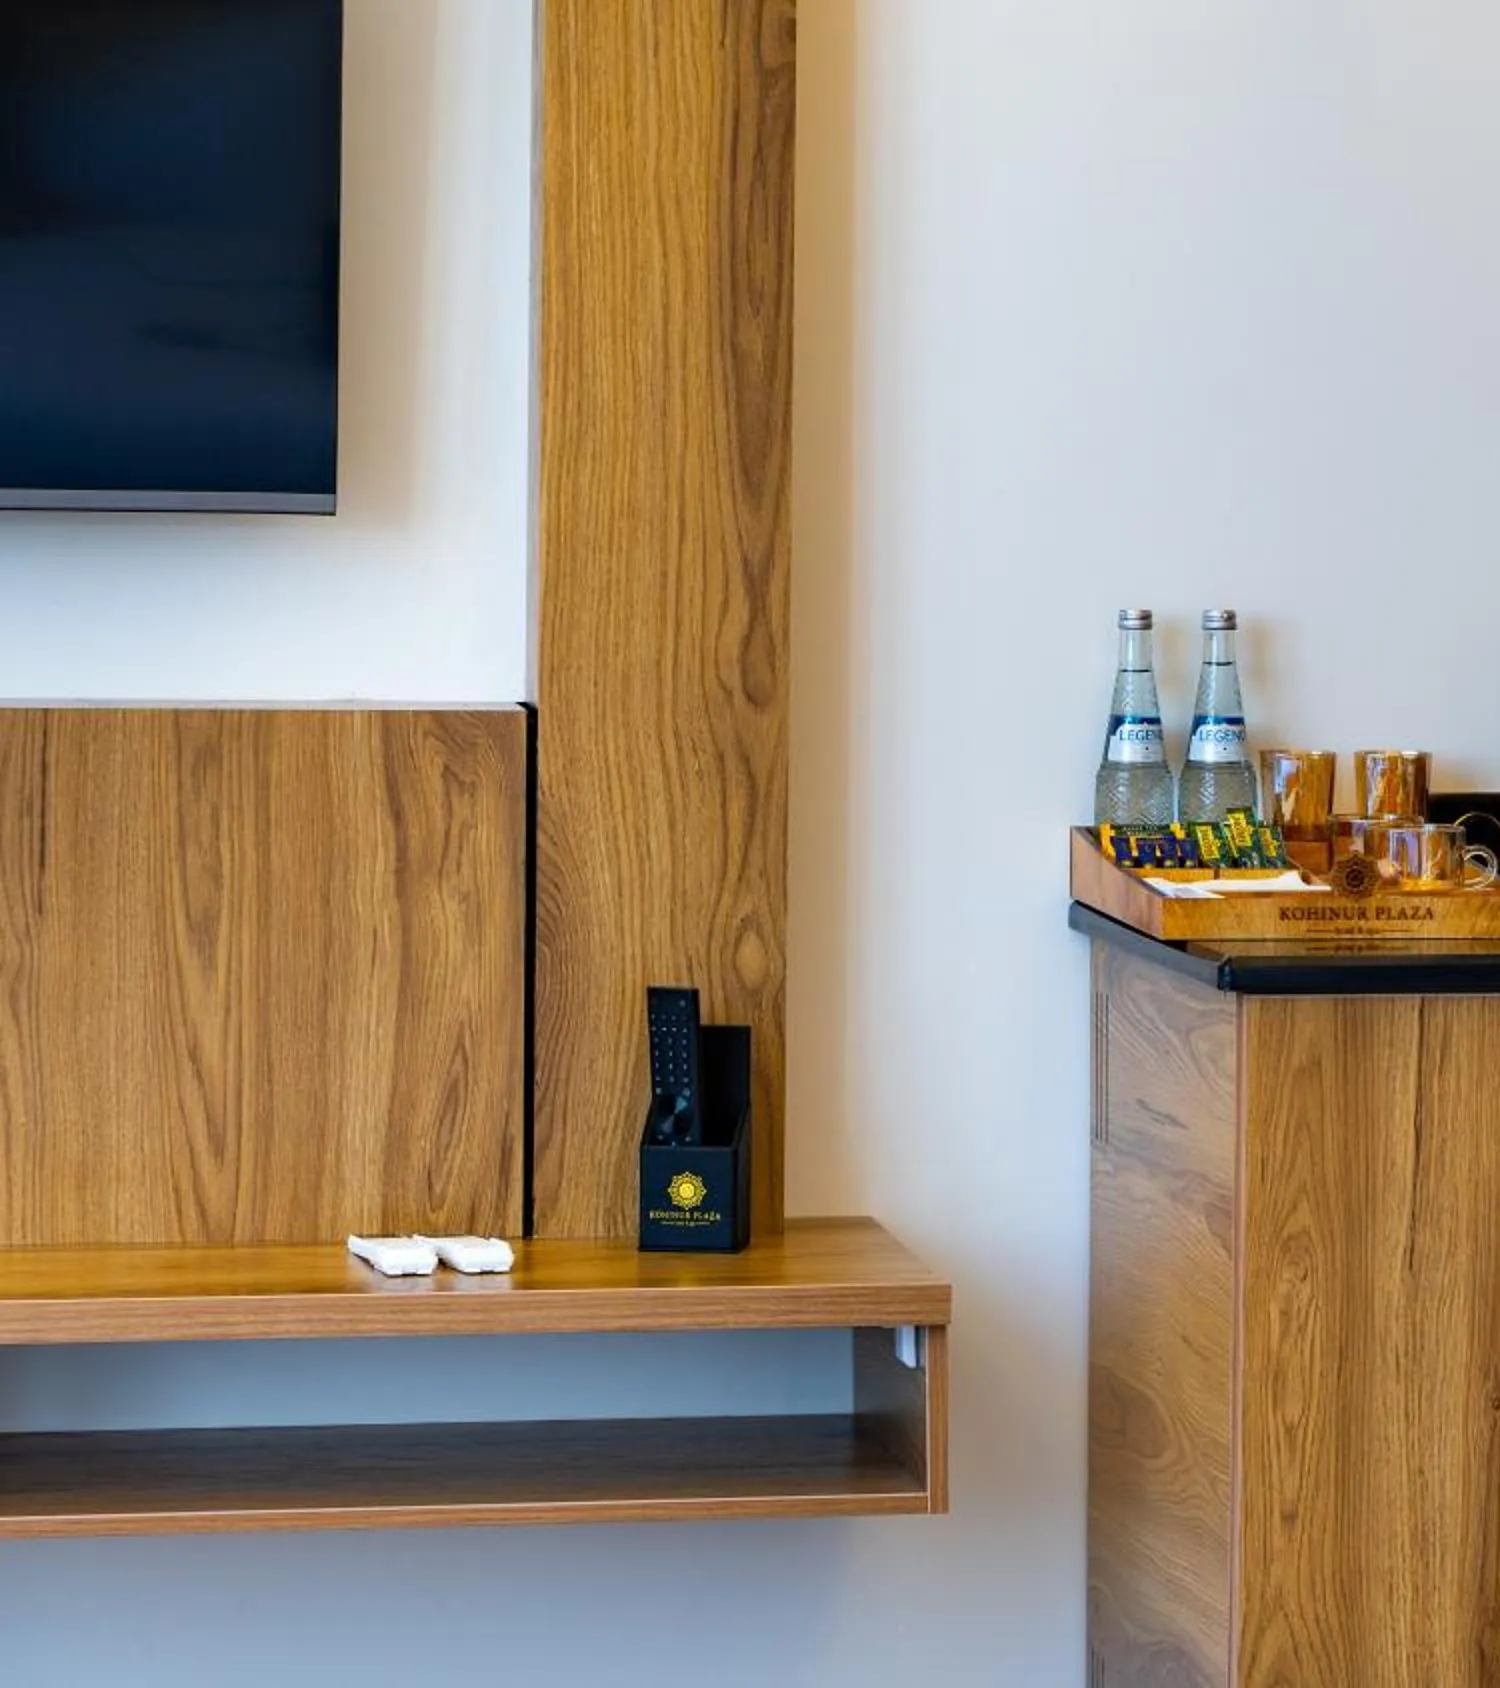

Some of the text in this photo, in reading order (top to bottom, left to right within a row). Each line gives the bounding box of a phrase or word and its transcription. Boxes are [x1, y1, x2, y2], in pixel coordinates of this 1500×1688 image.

[1278, 905, 1434, 921] KOHINUR PLAZA
[693, 1210, 721, 1221] PLAZA
